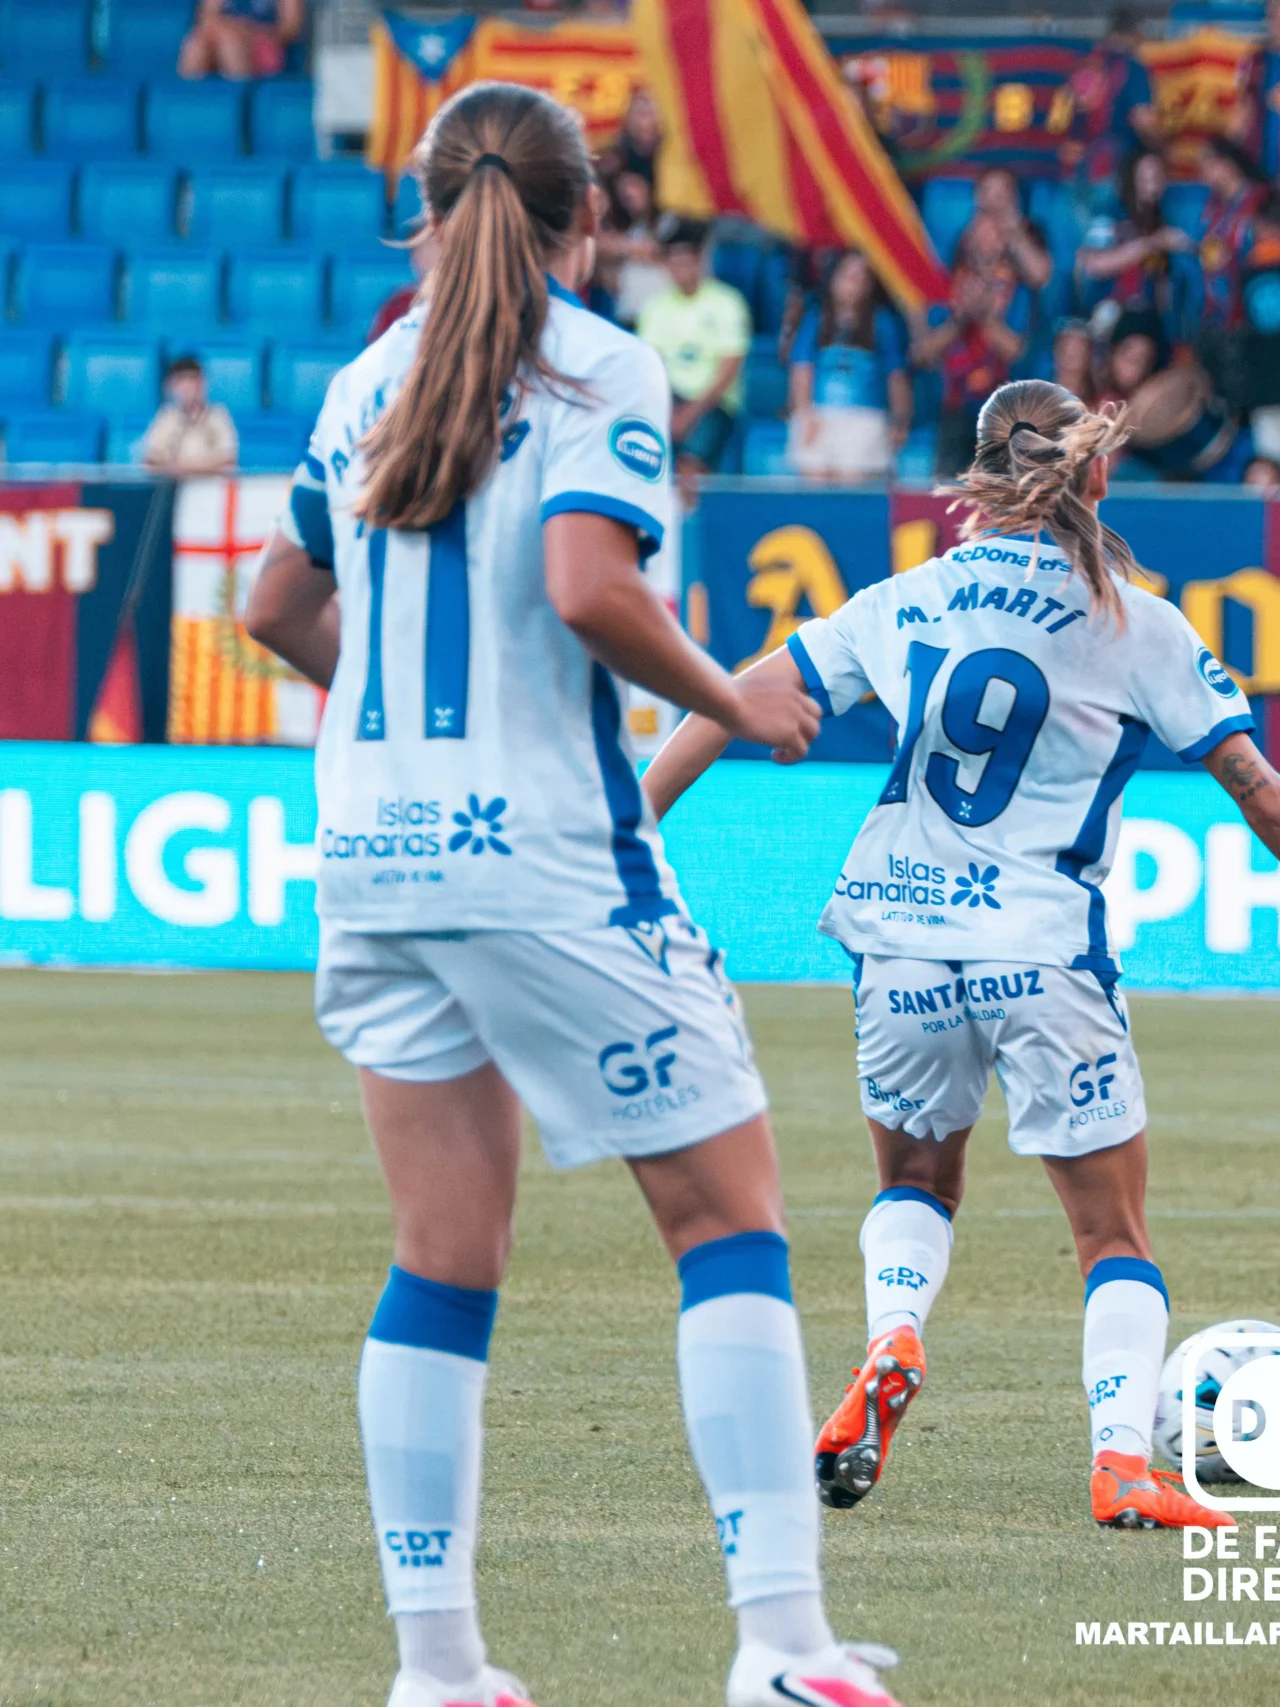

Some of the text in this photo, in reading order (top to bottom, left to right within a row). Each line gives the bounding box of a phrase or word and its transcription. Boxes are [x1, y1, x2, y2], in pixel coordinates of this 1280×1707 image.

[897, 582, 1087, 635] M. MARTÍ
[878, 640, 1052, 828] 19
[376, 796, 440, 827] Islas
[888, 853, 946, 885] Islas
[834, 872, 946, 906] Canarias
[967, 969, 1045, 1004] CRUZ
[921, 1020, 948, 1034] POR
[947, 1014, 964, 1029] LA
[598, 1023, 678, 1098] GF
[1069, 1052, 1117, 1108] GF
[1069, 1100, 1128, 1129] HOTELES
[878, 1266, 929, 1288] CDT
[1089, 1374, 1128, 1396] DT
[384, 1529, 453, 1554] CDT
